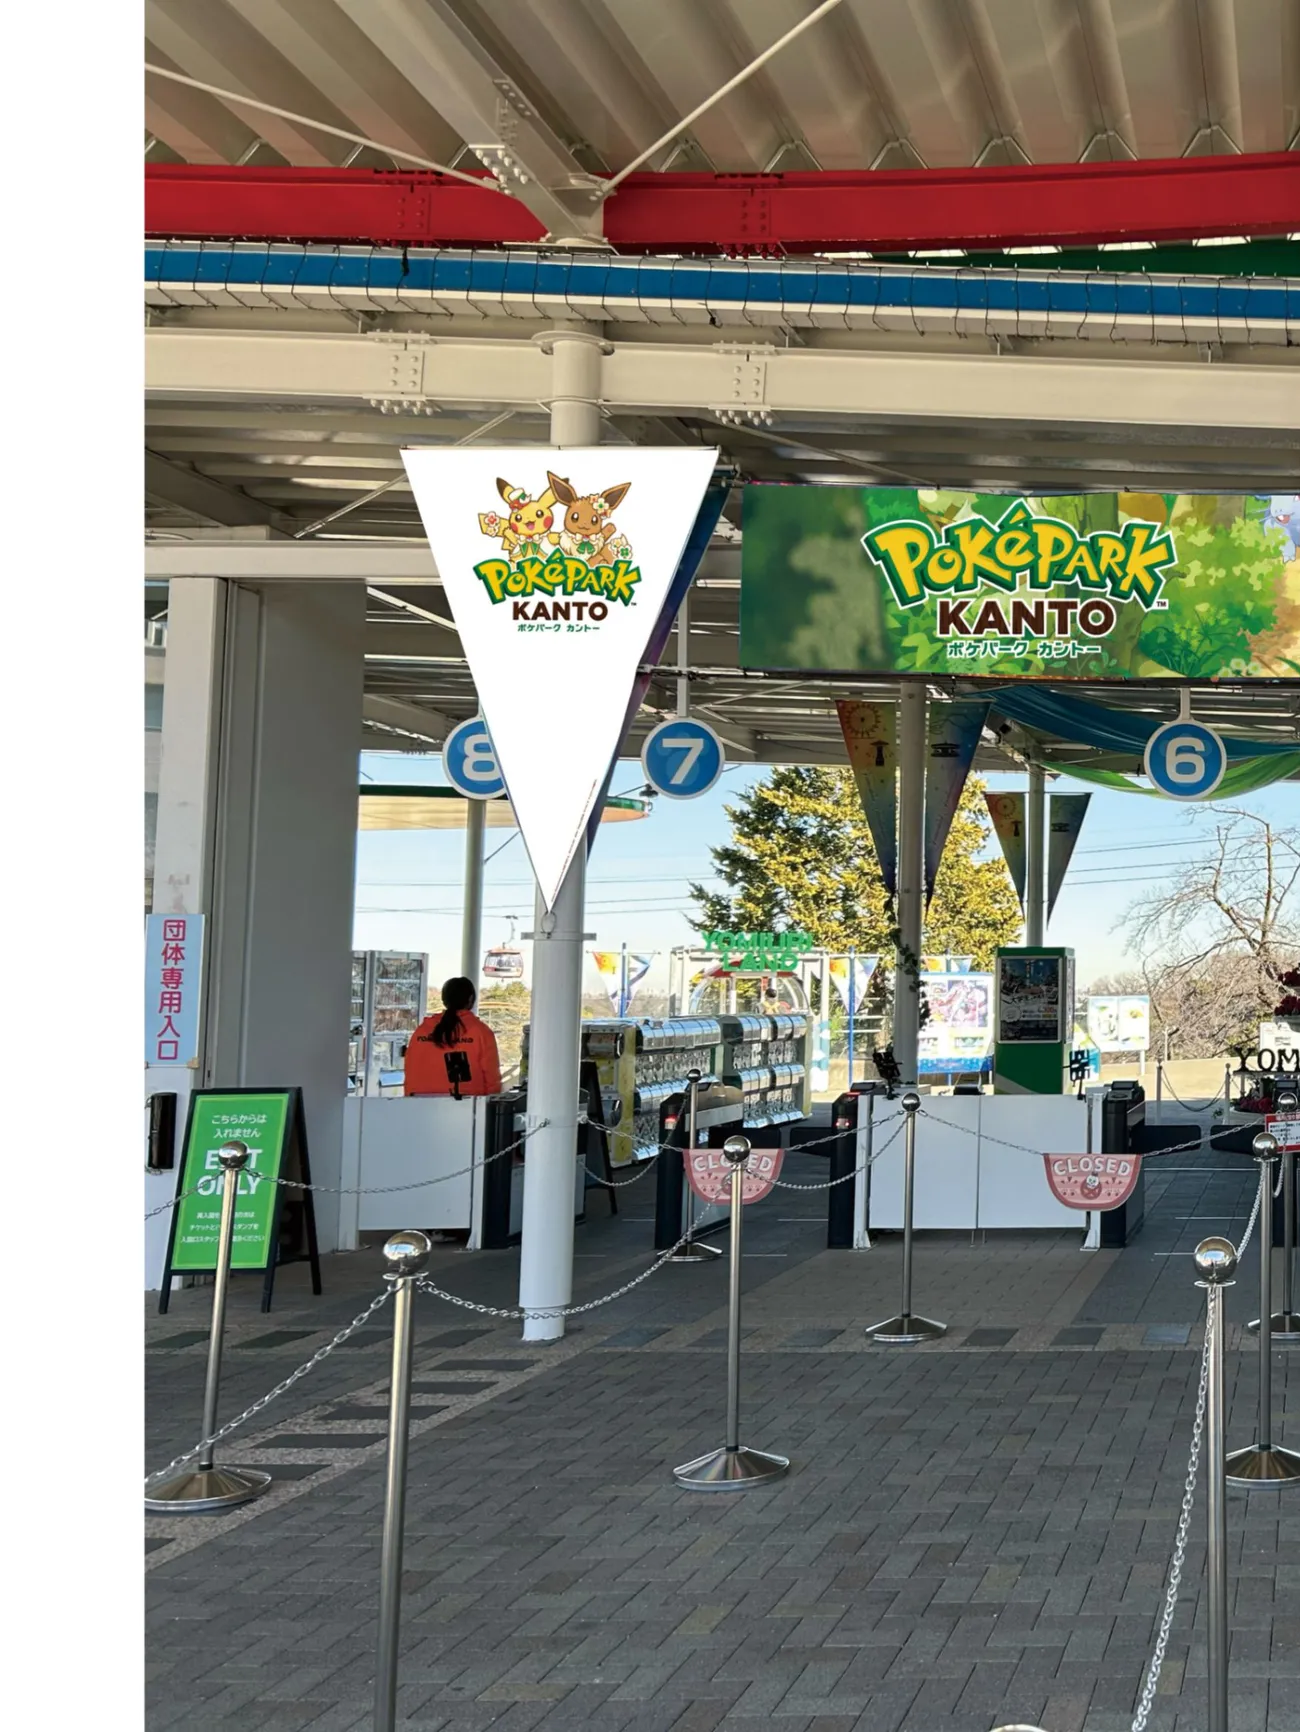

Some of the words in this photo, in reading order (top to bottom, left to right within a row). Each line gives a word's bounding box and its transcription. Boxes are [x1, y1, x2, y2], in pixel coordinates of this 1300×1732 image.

[513, 601, 609, 621] KANTO
[937, 599, 1116, 637] KANTO
[517, 624, 561, 632] ポケパーク
[566, 624, 600, 632] カントー
[947, 641, 1028, 659] ポケパーク
[1038, 641, 1102, 659] カントー
[463, 734, 500, 781] 8
[662, 738, 704, 784] 7
[1165, 737, 1206, 783] 6
[701, 930, 814, 952] YOMIURI
[722, 952, 799, 972] LAND
[157, 919, 187, 1060] 団体専用入口
[211, 1114, 267, 1124] こちらからは
[213, 1128, 261, 1138] 入れません
[204, 1149, 263, 1169] ET
[694, 1154, 773, 1172] CLOED
[1053, 1157, 1131, 1176] CLOSED
